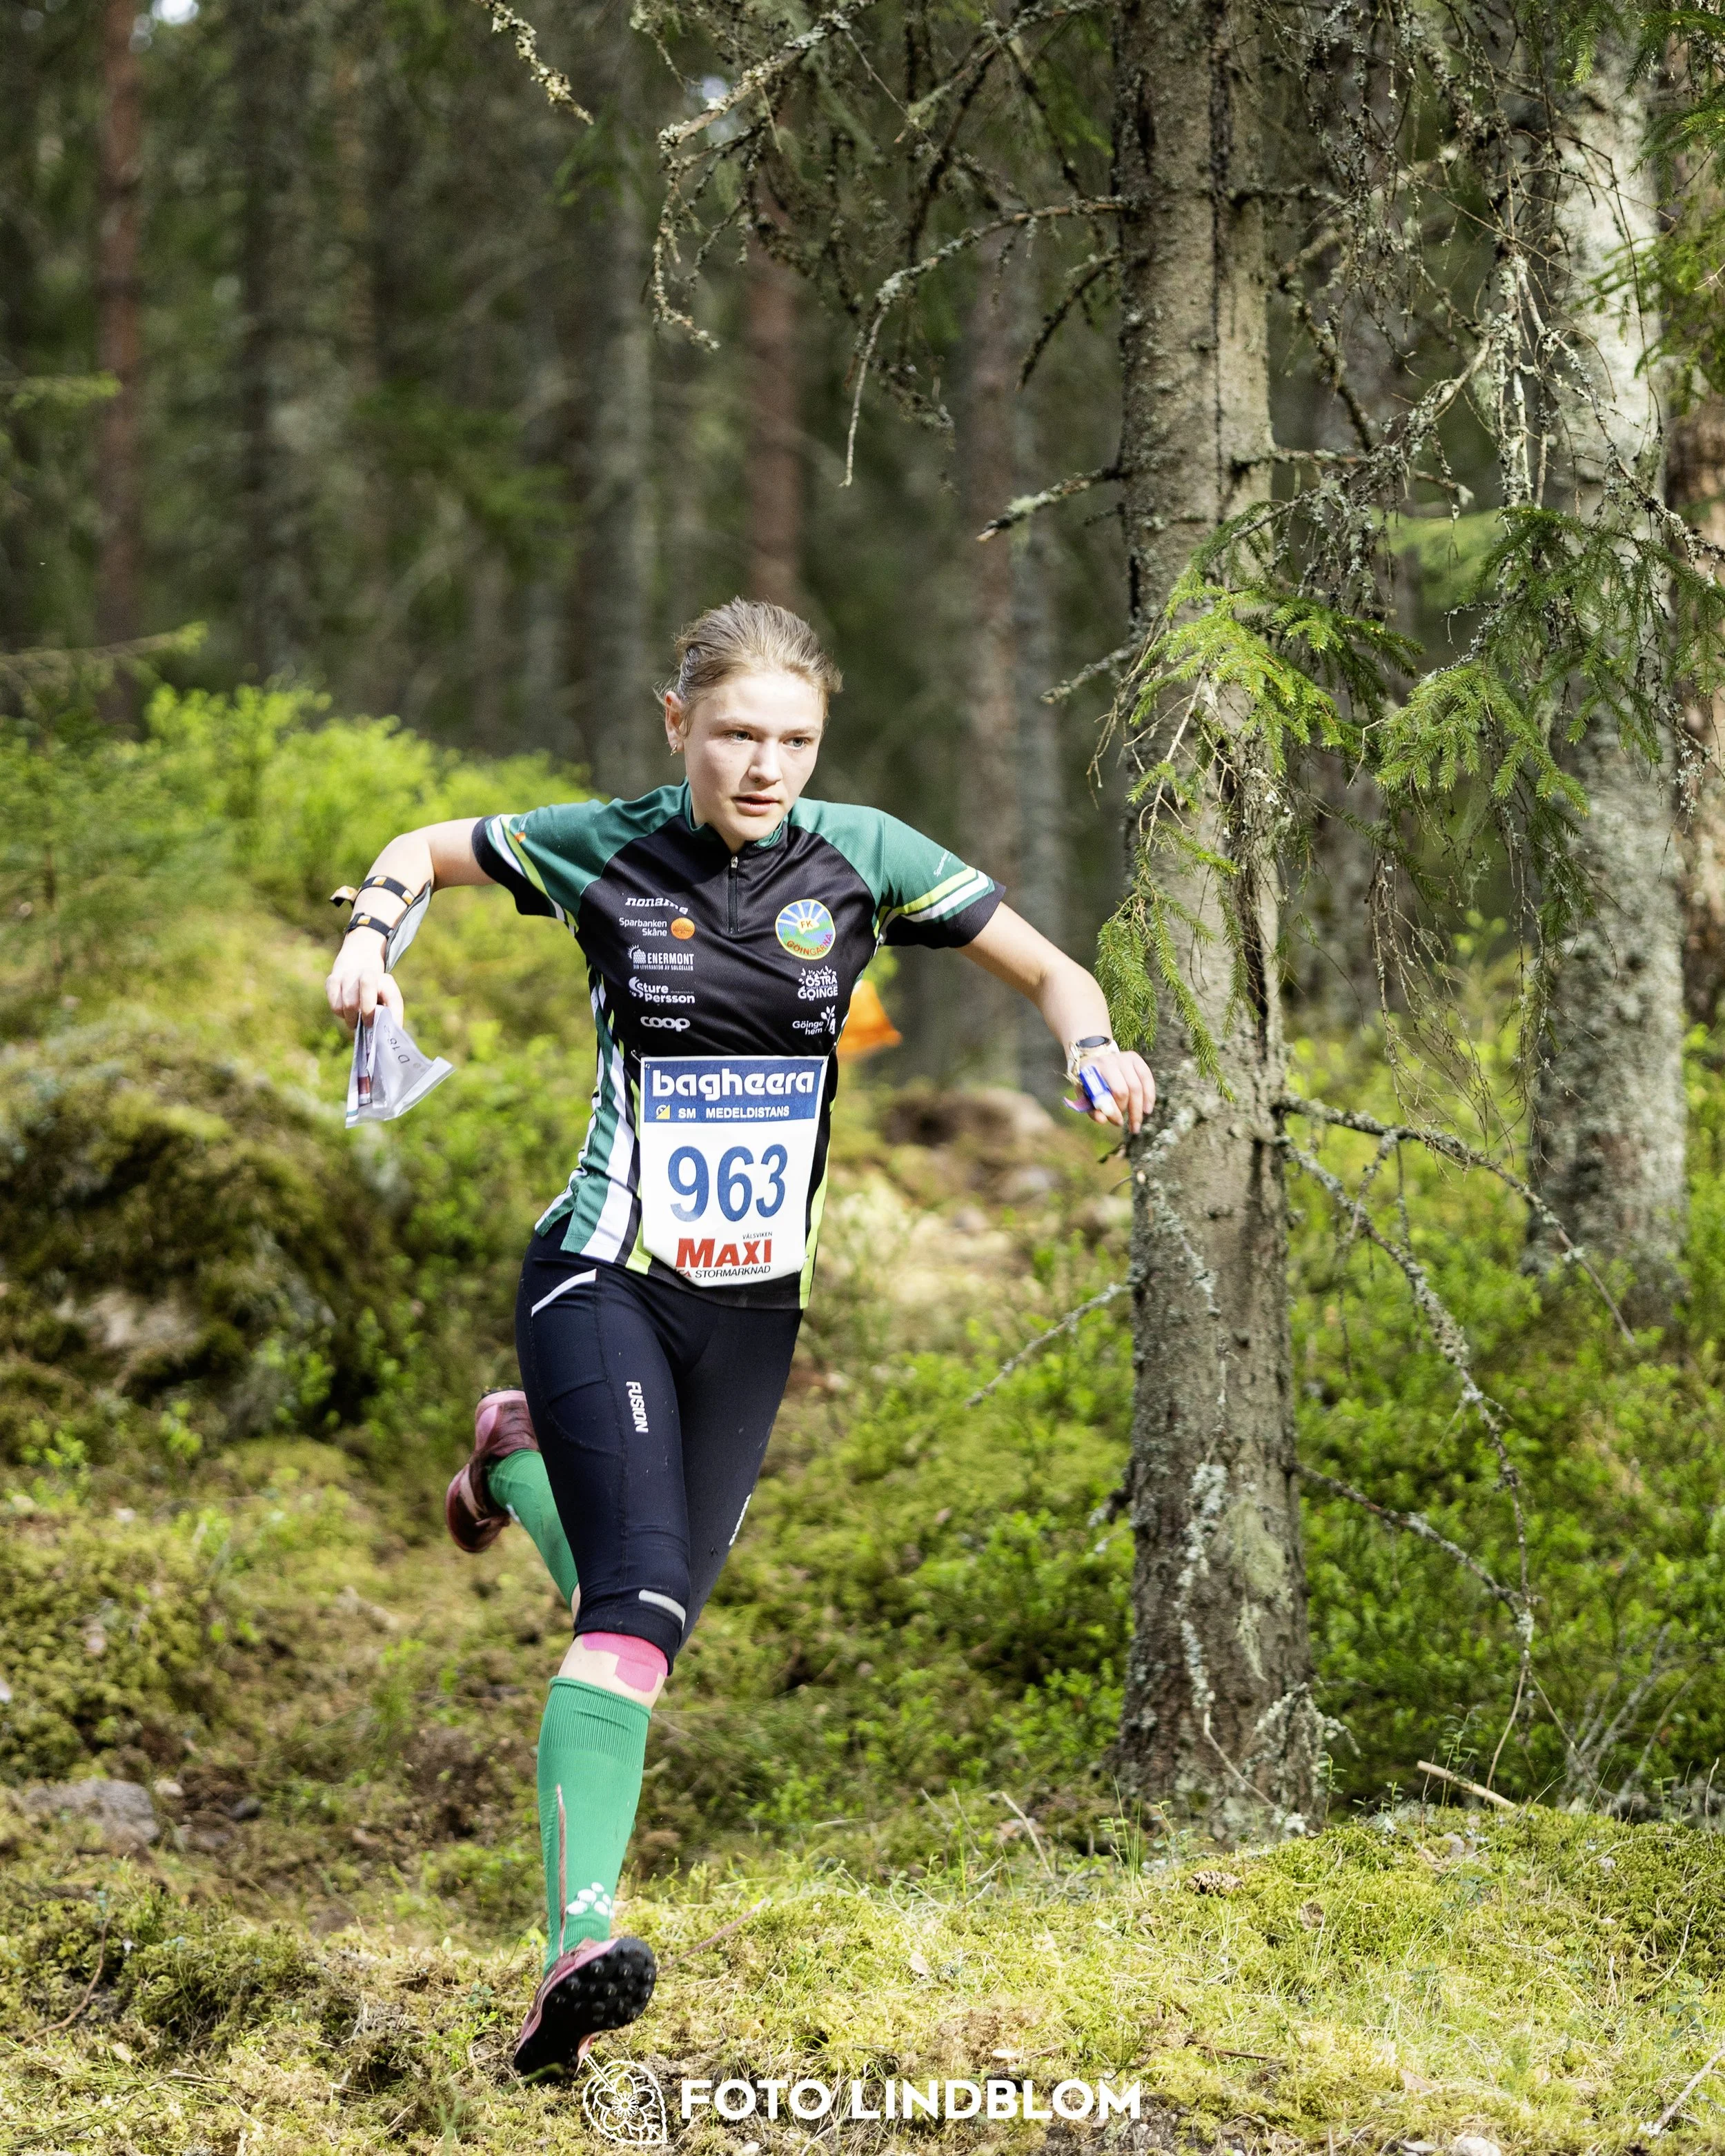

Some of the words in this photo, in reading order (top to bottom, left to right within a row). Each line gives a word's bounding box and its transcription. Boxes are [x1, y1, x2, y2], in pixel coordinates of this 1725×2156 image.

[618, 917, 668, 928] Sparbanken
[800, 920, 814, 929] FK
[642, 927, 668, 937] Skåne
[647, 952, 695, 965] ENERMONT
[640, 1016, 691, 1032] coop
[792, 1020, 824, 1029] Göinge
[805, 1027, 822, 1036] hem
[652, 1068, 815, 1101] bagheera
[678, 1107, 696, 1119] SM
[705, 1105, 789, 1119] MEDELDISTANS
[667, 1143, 788, 1223] 963
[676, 1238, 772, 1268] MAXI
[695, 1265, 771, 1278] STORMARKNAD
[626, 1381, 649, 1433] FUSION
